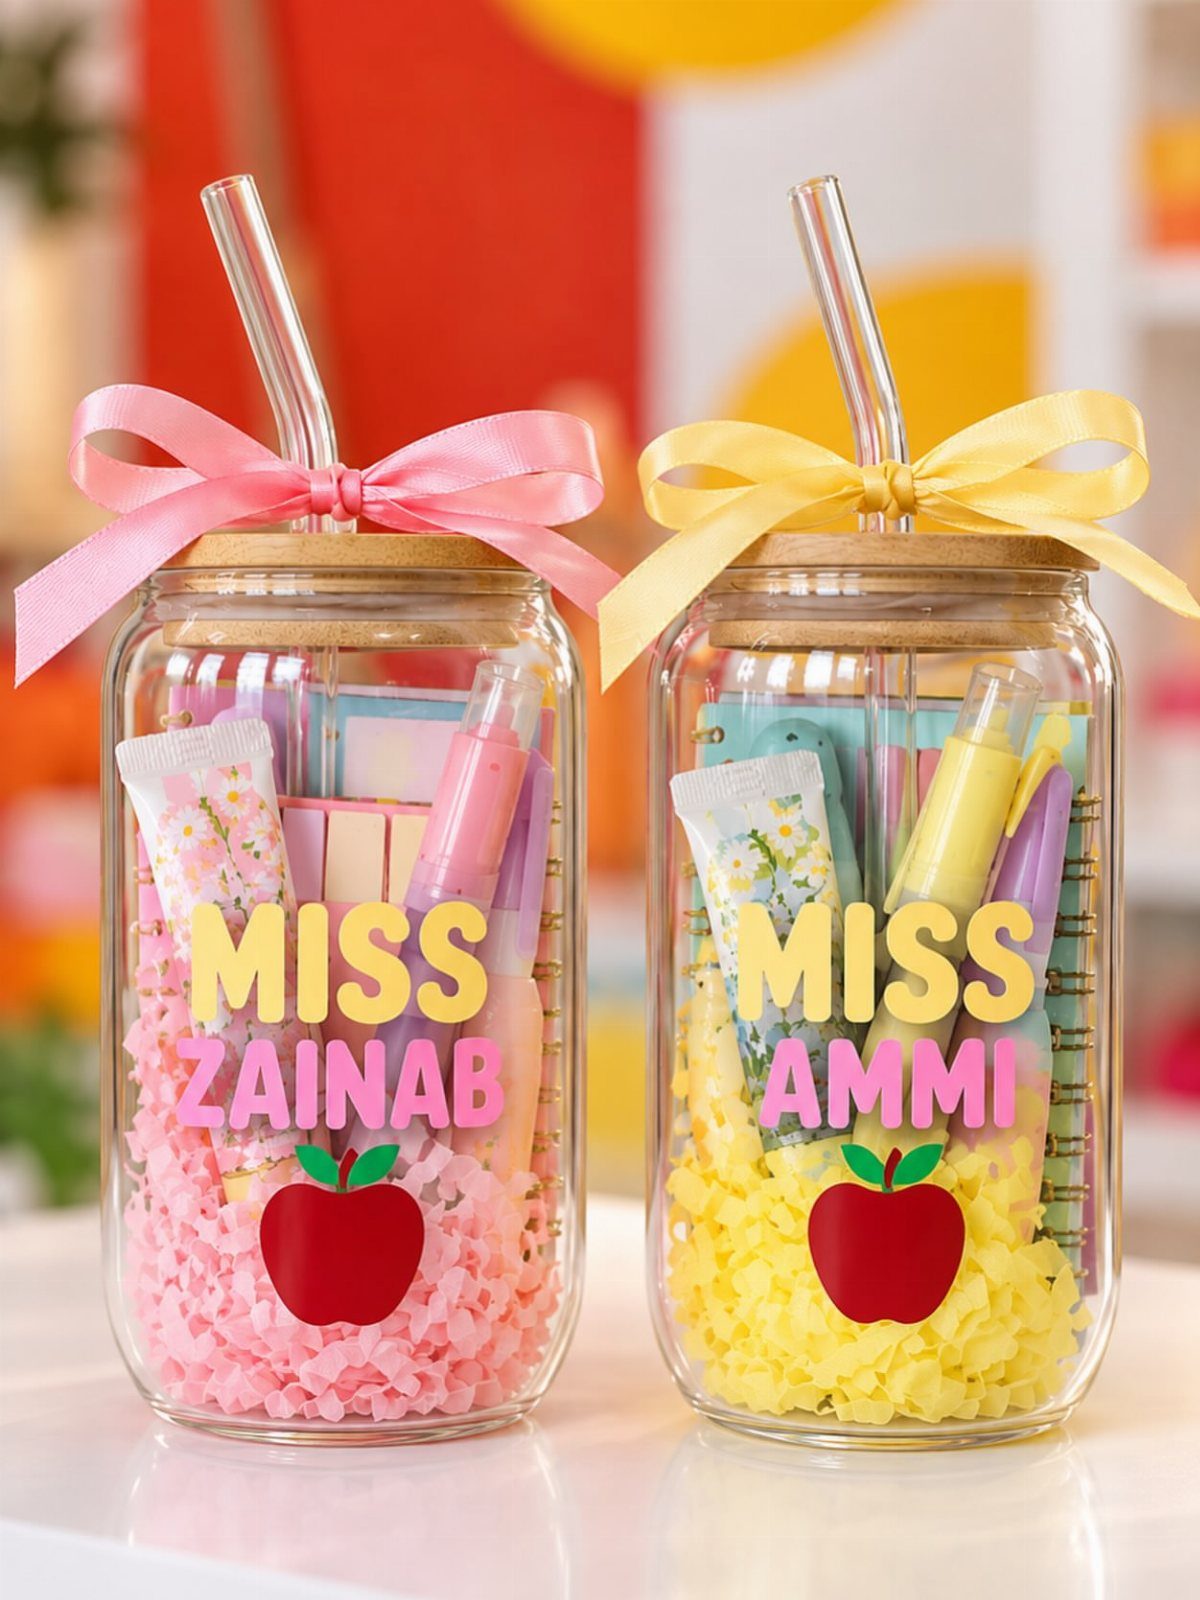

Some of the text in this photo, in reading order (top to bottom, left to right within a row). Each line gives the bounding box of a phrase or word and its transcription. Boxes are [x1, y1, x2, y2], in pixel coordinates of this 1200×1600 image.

[191, 902, 488, 1024] MISS
[737, 902, 1034, 1024] MISS
[177, 1038, 504, 1129] ZAINAB
[759, 1038, 1015, 1128] AMMI
